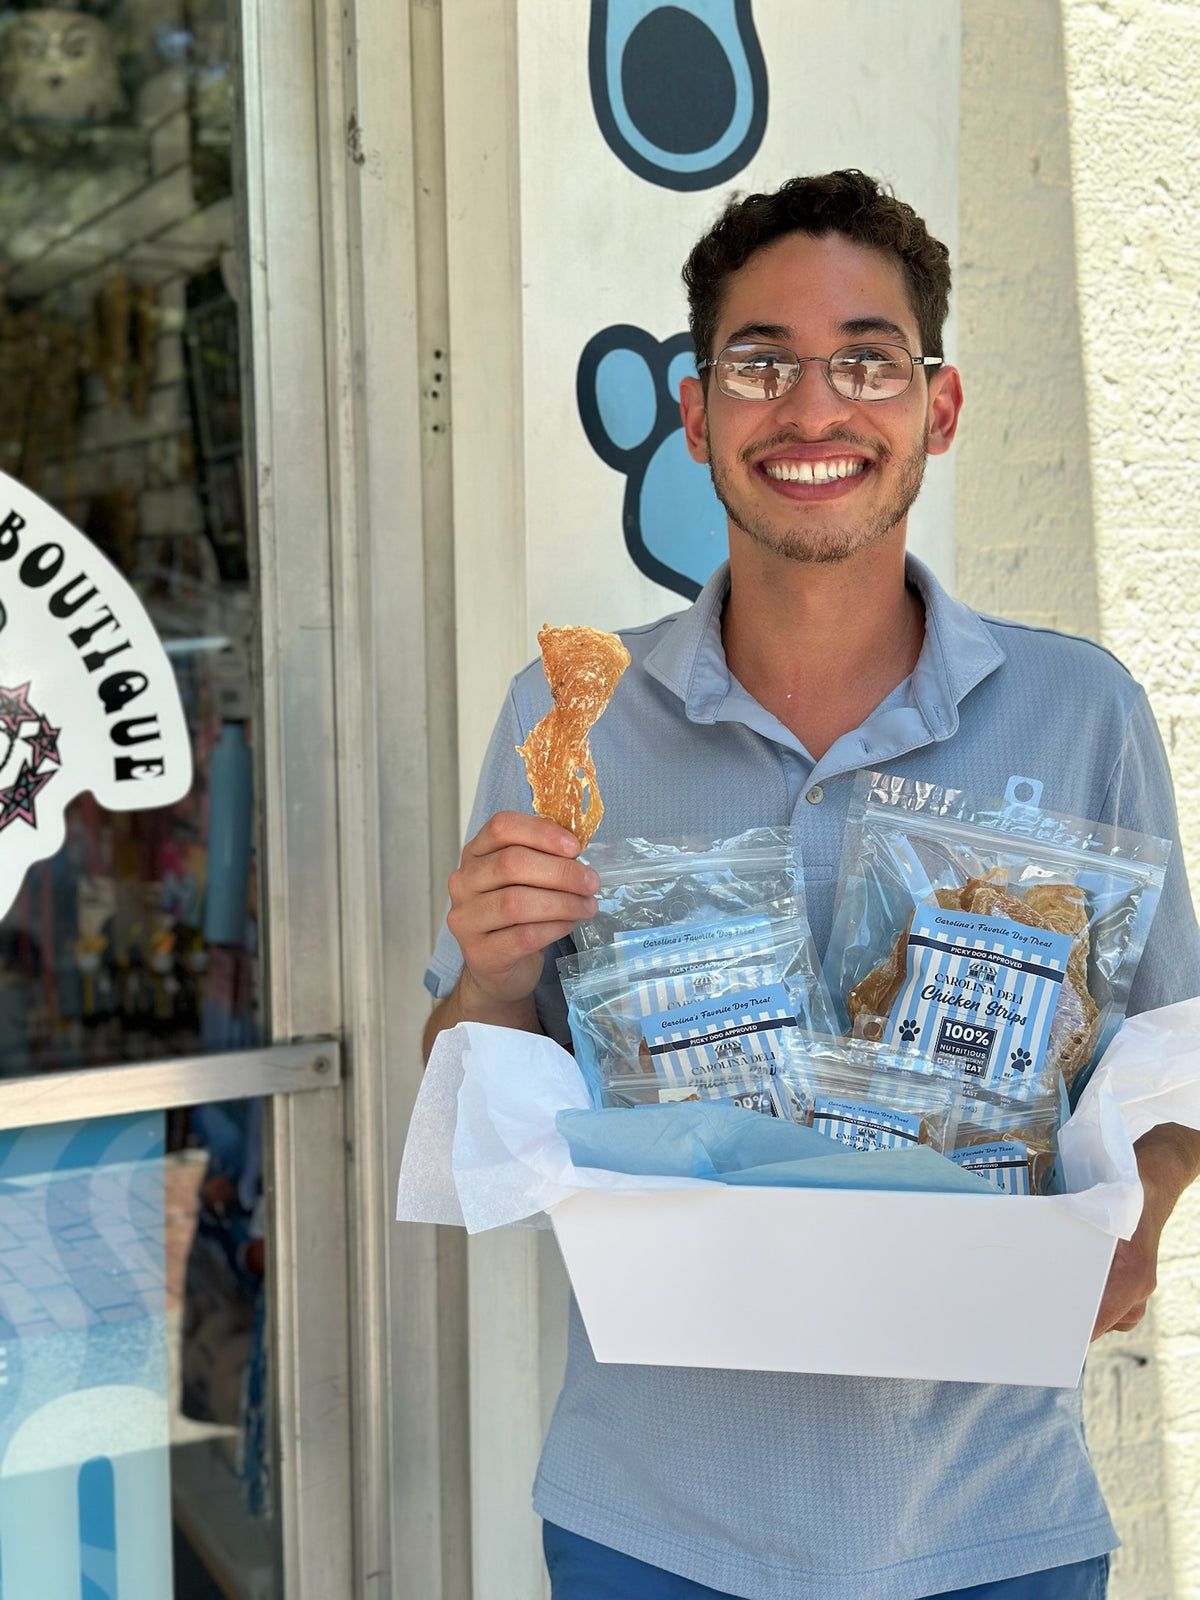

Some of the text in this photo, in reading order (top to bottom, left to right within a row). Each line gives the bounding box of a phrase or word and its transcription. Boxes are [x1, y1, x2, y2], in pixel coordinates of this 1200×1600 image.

[0, 509, 166, 782] BOUTIQUE
[643, 935, 681, 948] Carolina's
[683, 932, 715, 944] Favorite
[717, 929, 732, 939] Dog
[934, 916, 1053, 948] Carolina's Favorite Dog Treat
[669, 964, 690, 974] PICKY
[690, 962, 704, 971] DOG
[950, 946, 1023, 969] PICKY DOG APPROVED
[934, 972, 1024, 1005] CAROLINA DELI
[661, 996, 771, 1029] Carolina's Favorite Dog Treat
[921, 984, 1028, 1026] Chicken Strips
[690, 1025, 758, 1046] PICKY DOG APPROVED
[945, 1022, 990, 1046] 100%
[691, 1051, 776, 1076] CAROLINA DELI
[940, 1043, 987, 1060] NUTRITIOUS
[836, 1132, 877, 1147] CAROLINA
